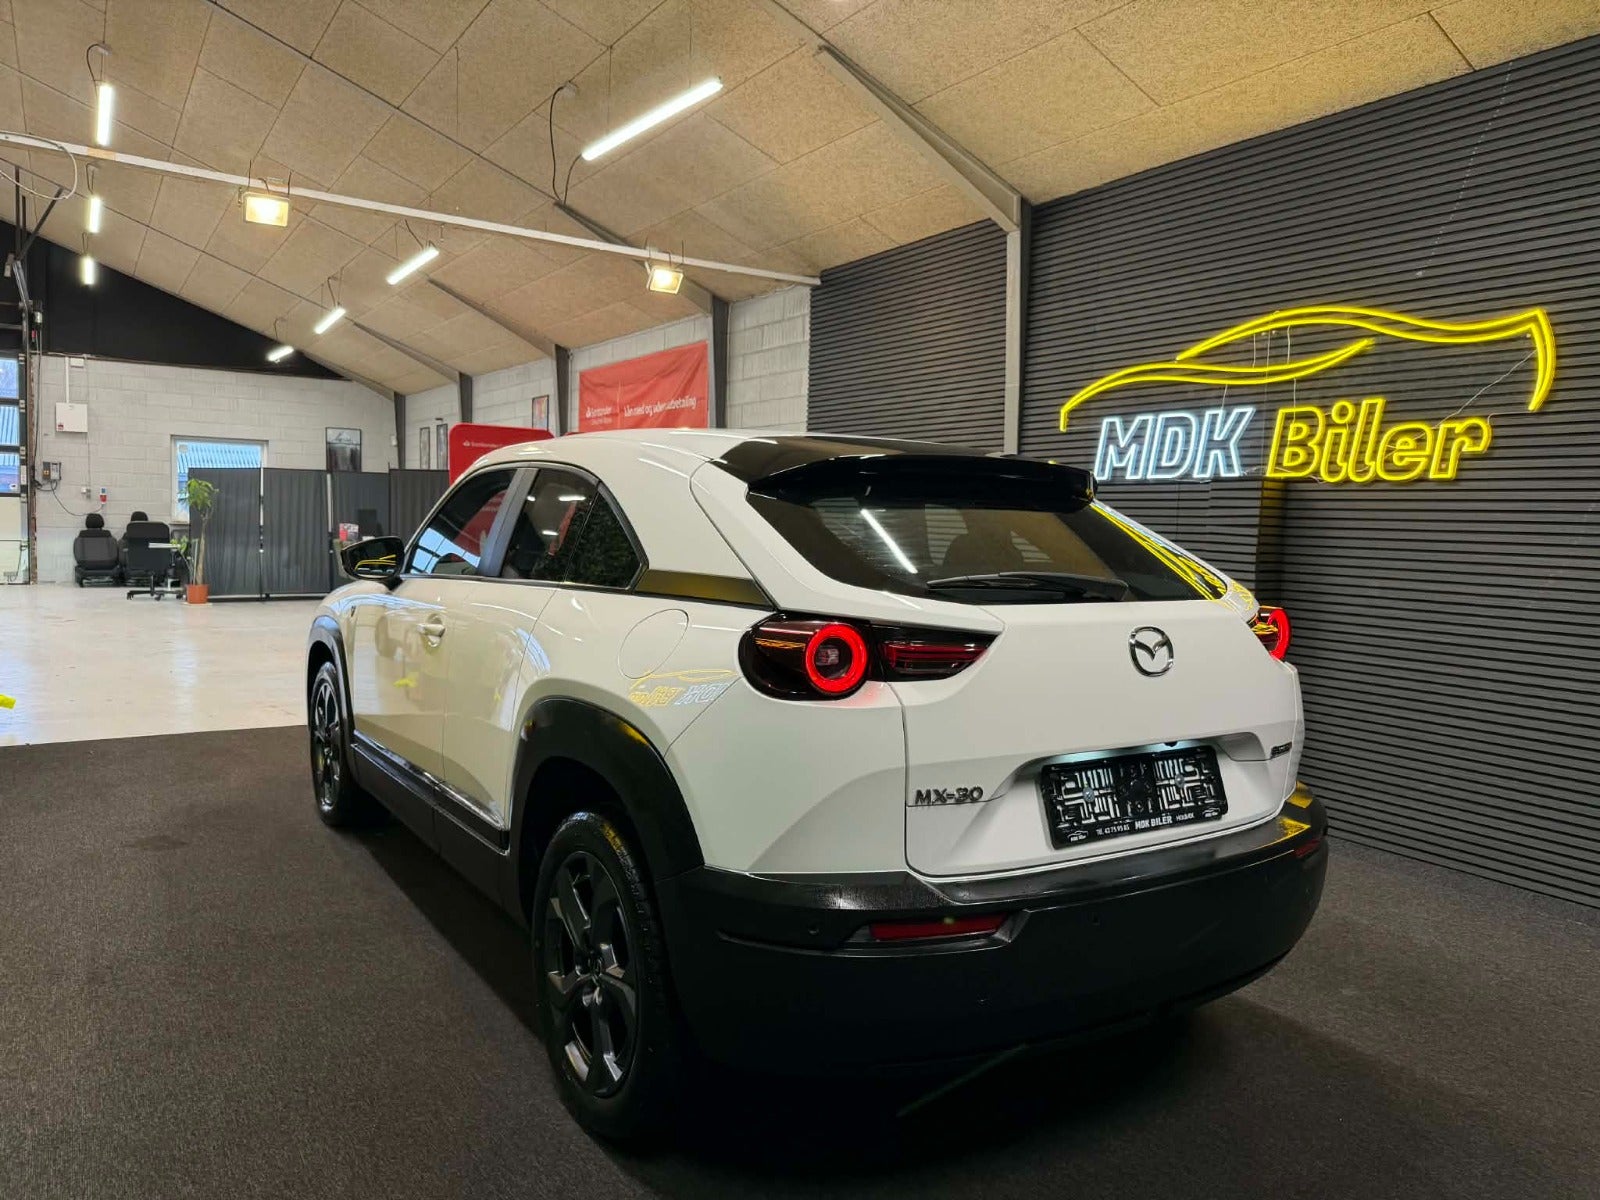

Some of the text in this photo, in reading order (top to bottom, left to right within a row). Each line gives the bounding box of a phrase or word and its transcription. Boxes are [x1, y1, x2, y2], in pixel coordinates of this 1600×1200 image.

[1093, 398, 1491, 483] MDK Biler
[915, 787, 984, 804] MX-30
[1151, 815, 1173, 827] BILER
